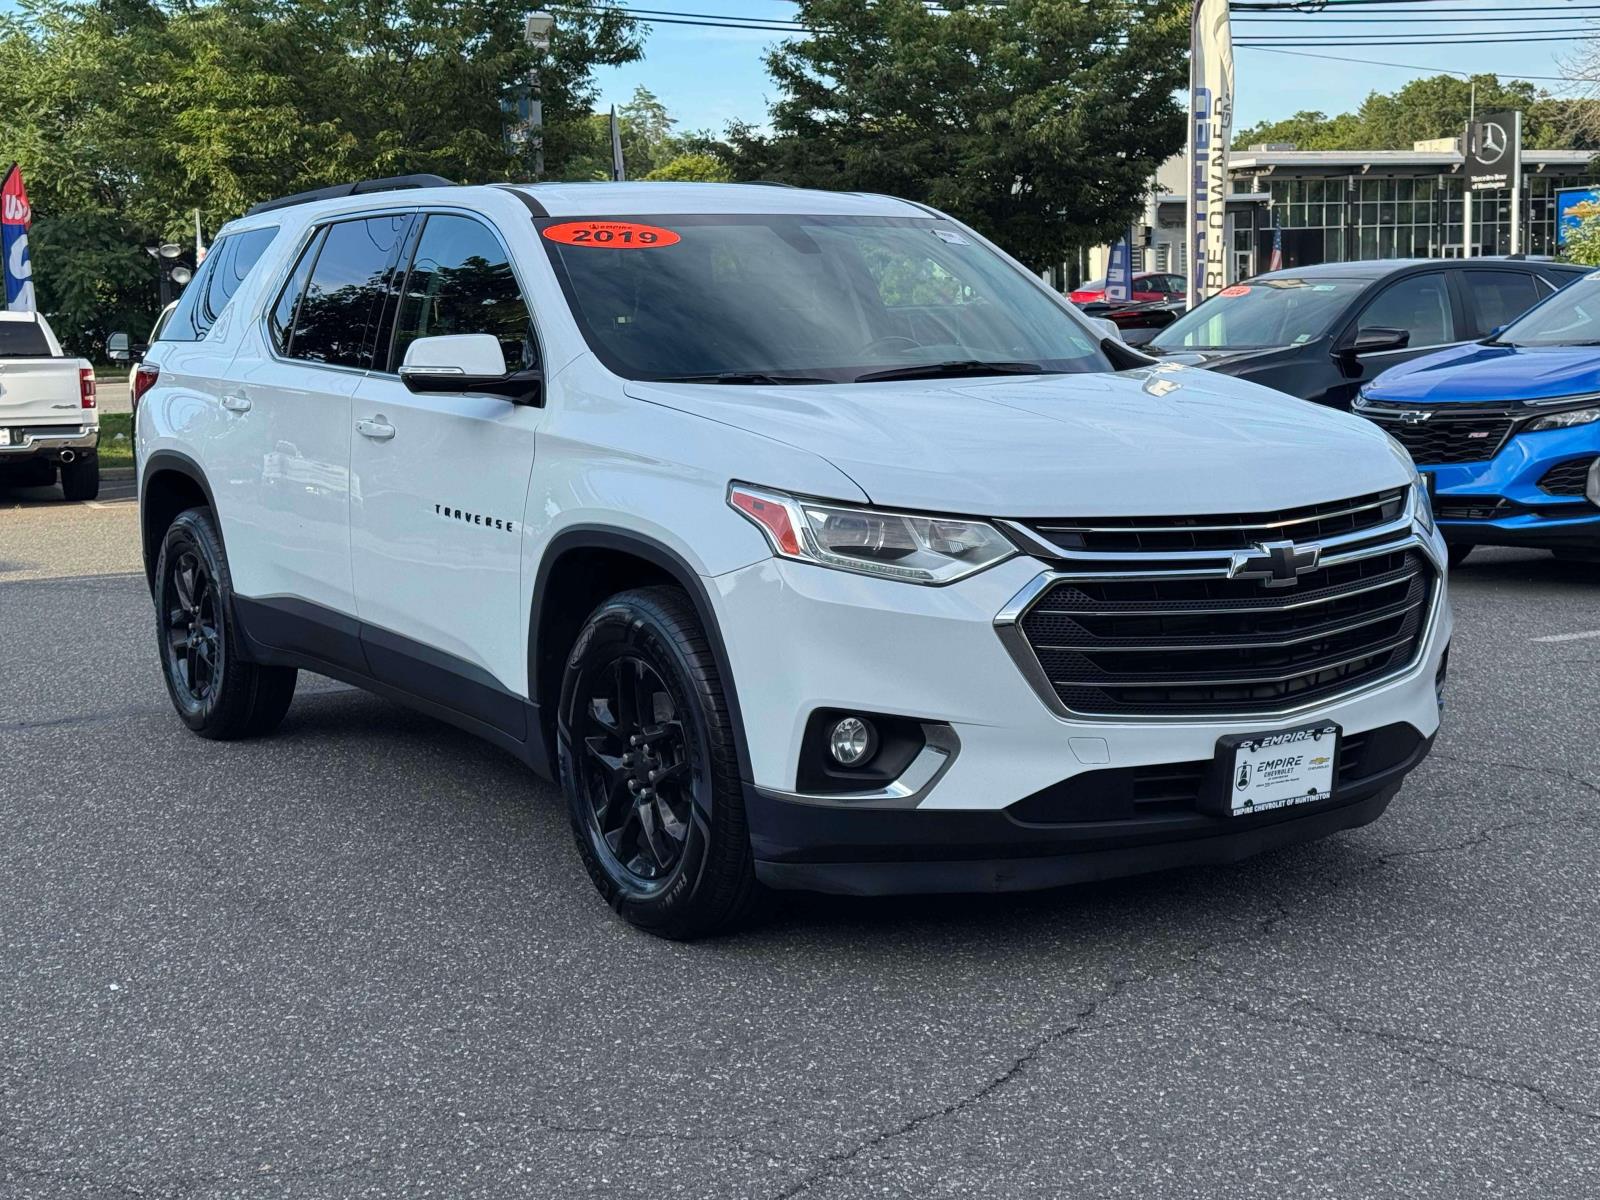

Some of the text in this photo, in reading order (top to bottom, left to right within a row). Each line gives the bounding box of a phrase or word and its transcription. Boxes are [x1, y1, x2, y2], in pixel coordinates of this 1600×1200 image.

[572, 230, 658, 243] 2019
[434, 504, 513, 533] TRAVERSE
[1261, 730, 1315, 747] EMPIRE
[1257, 755, 1303, 772] EMPIRE
[1263, 767, 1294, 778] CHEVROLET
[1233, 806, 1253, 816] EMPIRE
[1254, 800, 1285, 812] CHEVROLET
[1286, 798, 1294, 806] OF
